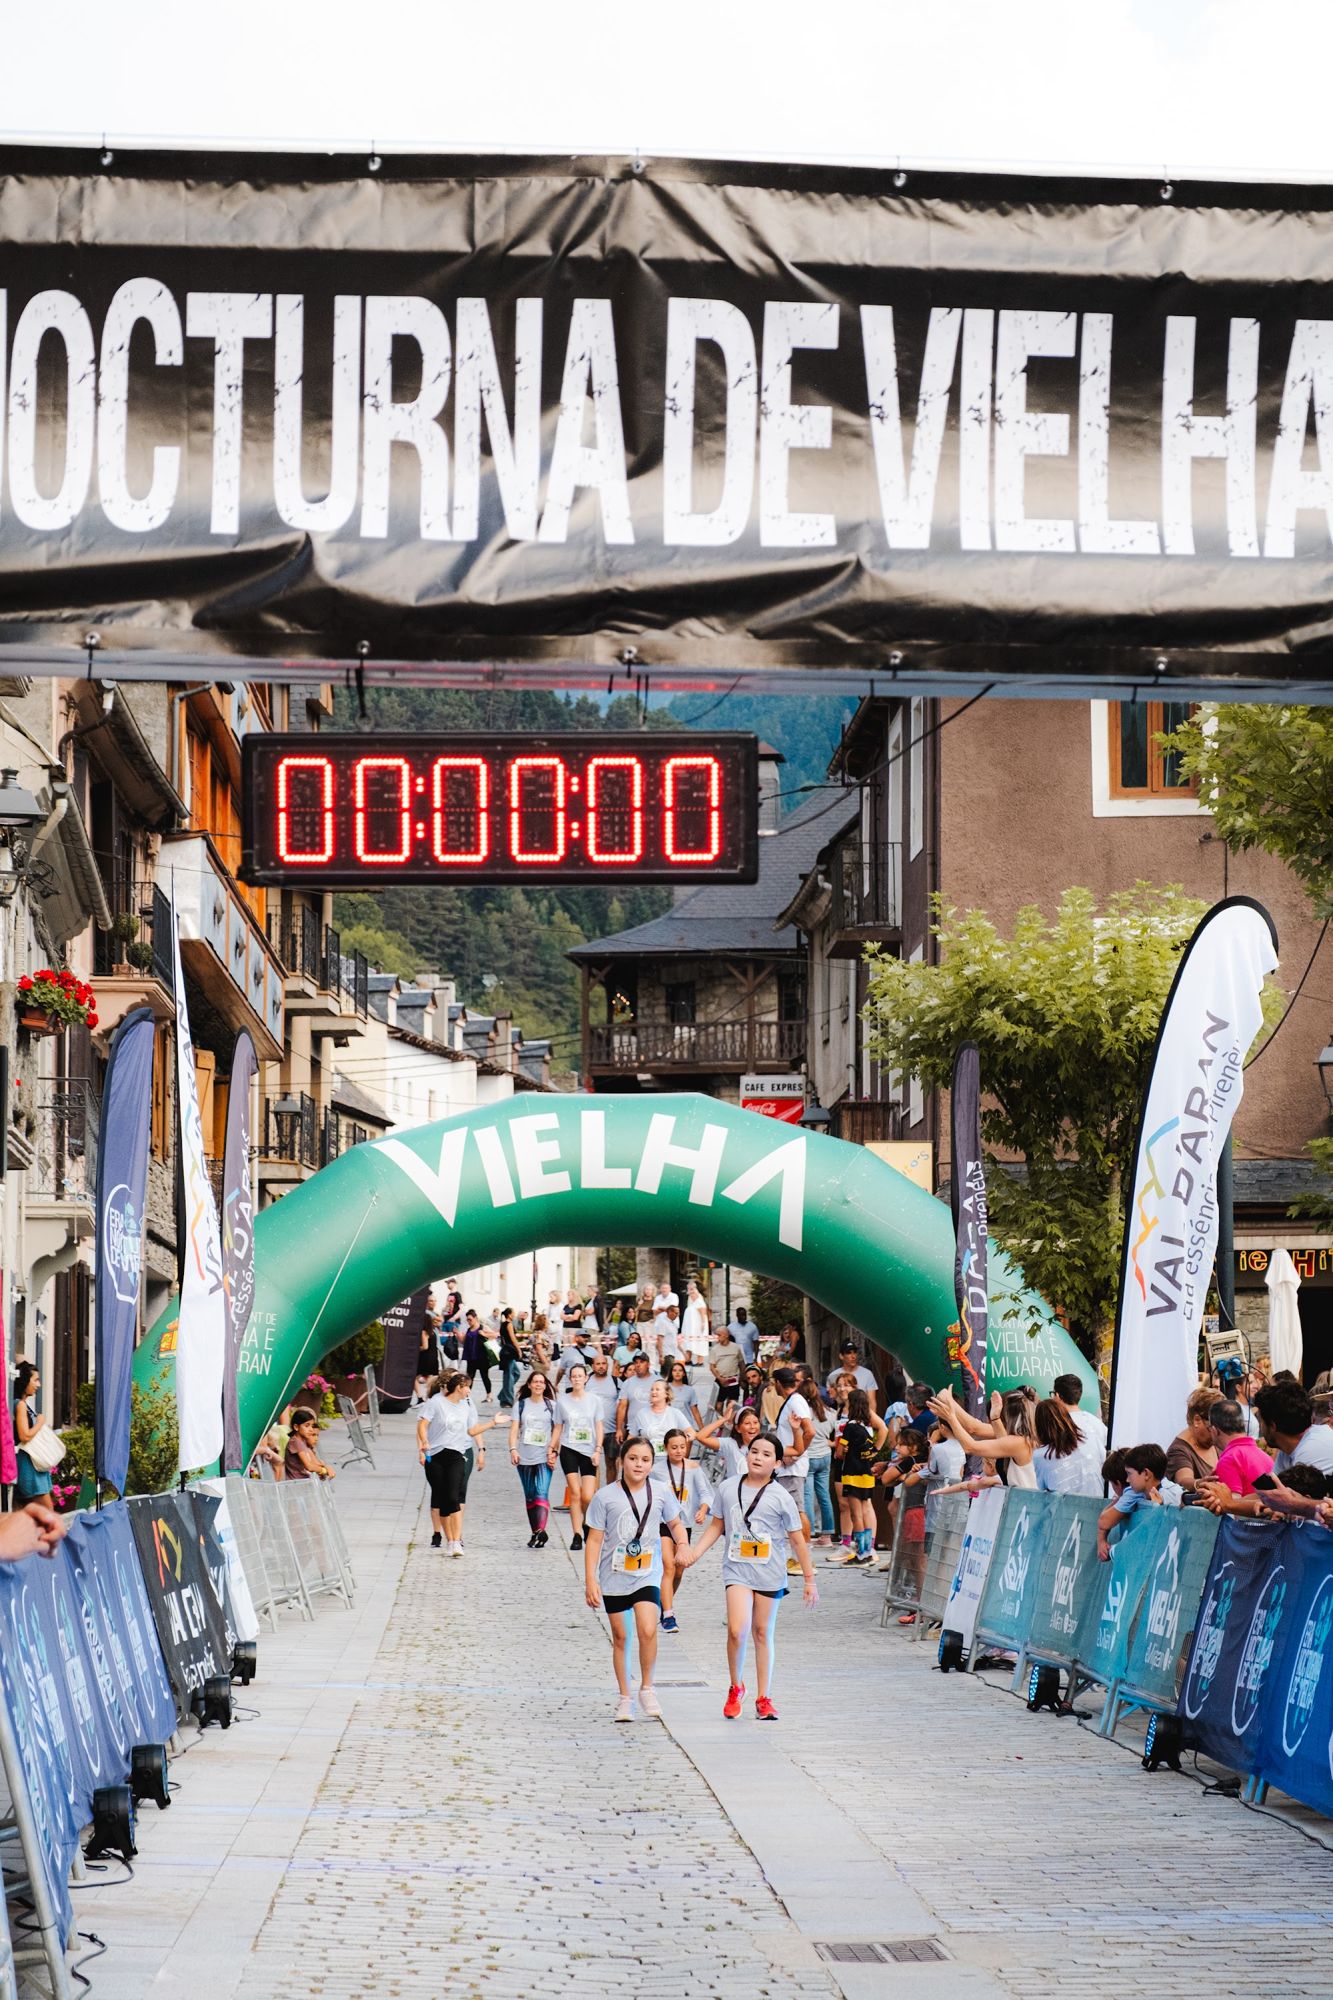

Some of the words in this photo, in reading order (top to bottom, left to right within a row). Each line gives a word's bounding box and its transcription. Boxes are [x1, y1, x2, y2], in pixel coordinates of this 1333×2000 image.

[0, 276, 635, 544] OCTURNA
[663, 296, 840, 548] DE
[860, 304, 1333, 559] VIELHA
[277, 753, 721, 865] 00:00:00
[745, 1083, 765, 1092] CAFE
[771, 1083, 803, 1092] EXPRES
[370, 1110, 807, 1252] VIELHA
[989, 1331, 1047, 1354] VIELHA
[990, 1356, 1064, 1379] MIJARAN
[752, 1544, 758, 1557] 1
[637, 1557, 642, 1569] 1
